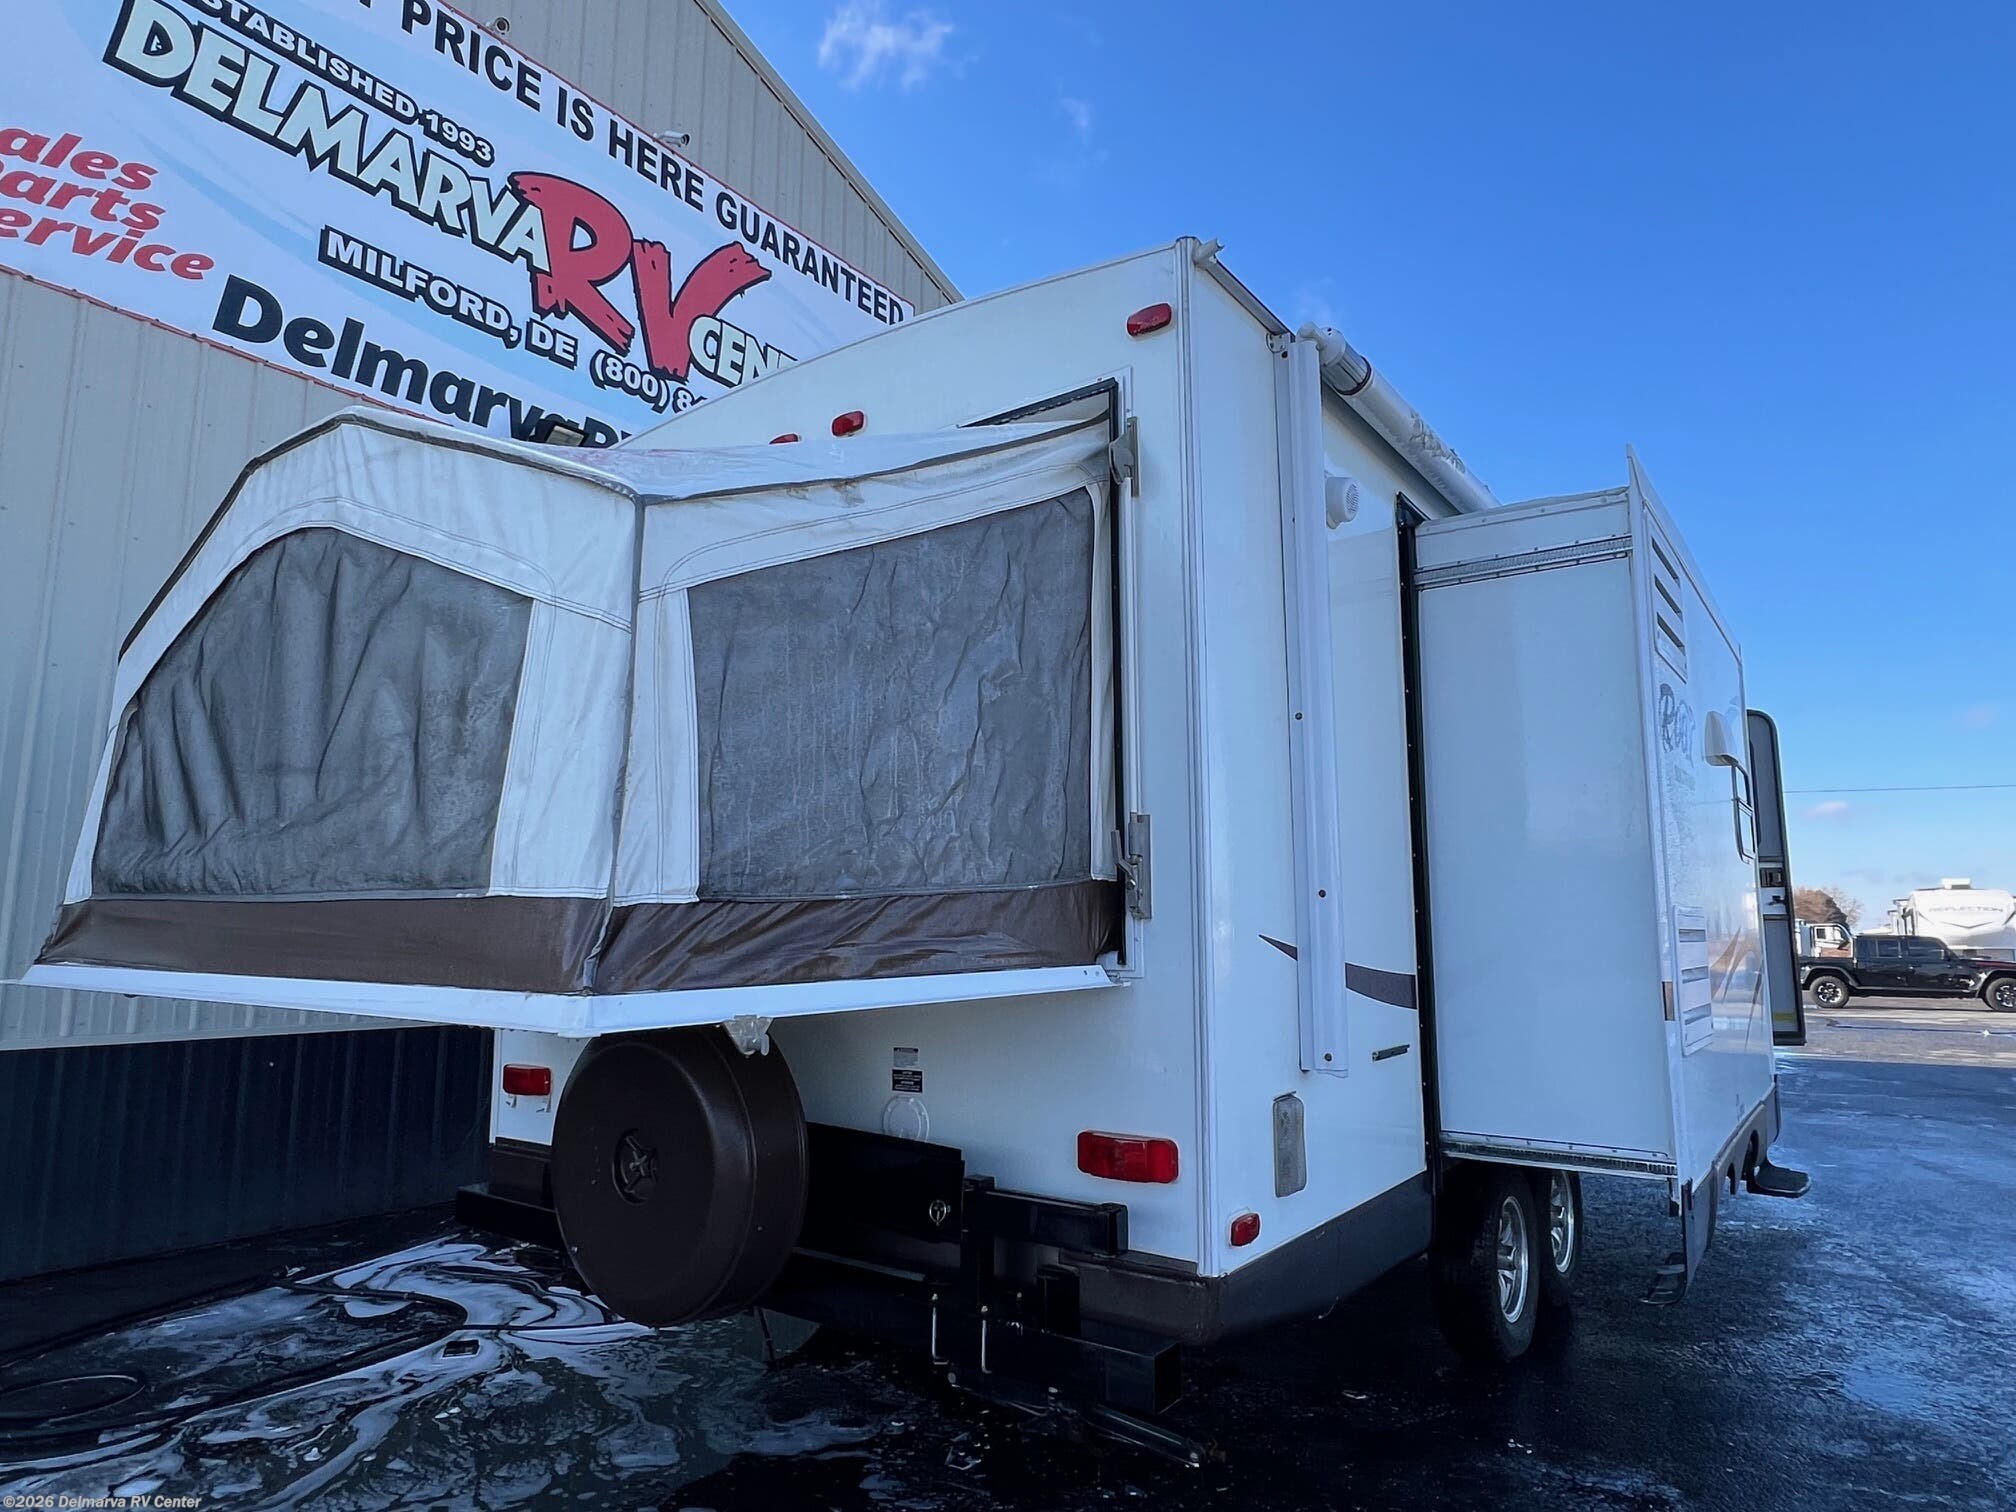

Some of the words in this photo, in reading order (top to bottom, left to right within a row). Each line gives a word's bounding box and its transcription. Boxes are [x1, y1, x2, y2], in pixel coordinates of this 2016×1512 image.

[0, 158, 166, 230] arts
[106, 0, 551, 273] DELMARVA
[508, 171, 772, 381] RV
[402, 0, 542, 113] PRICE
[557, 86, 594, 142] IS
[608, 118, 704, 212] HERE
[714, 188, 904, 326] GUARANTEED
[425, 113, 493, 162] 1993
[322, 227, 520, 343] MILFORD,
[528, 320, 577, 365] DE
[592, 351, 669, 410] (800)
